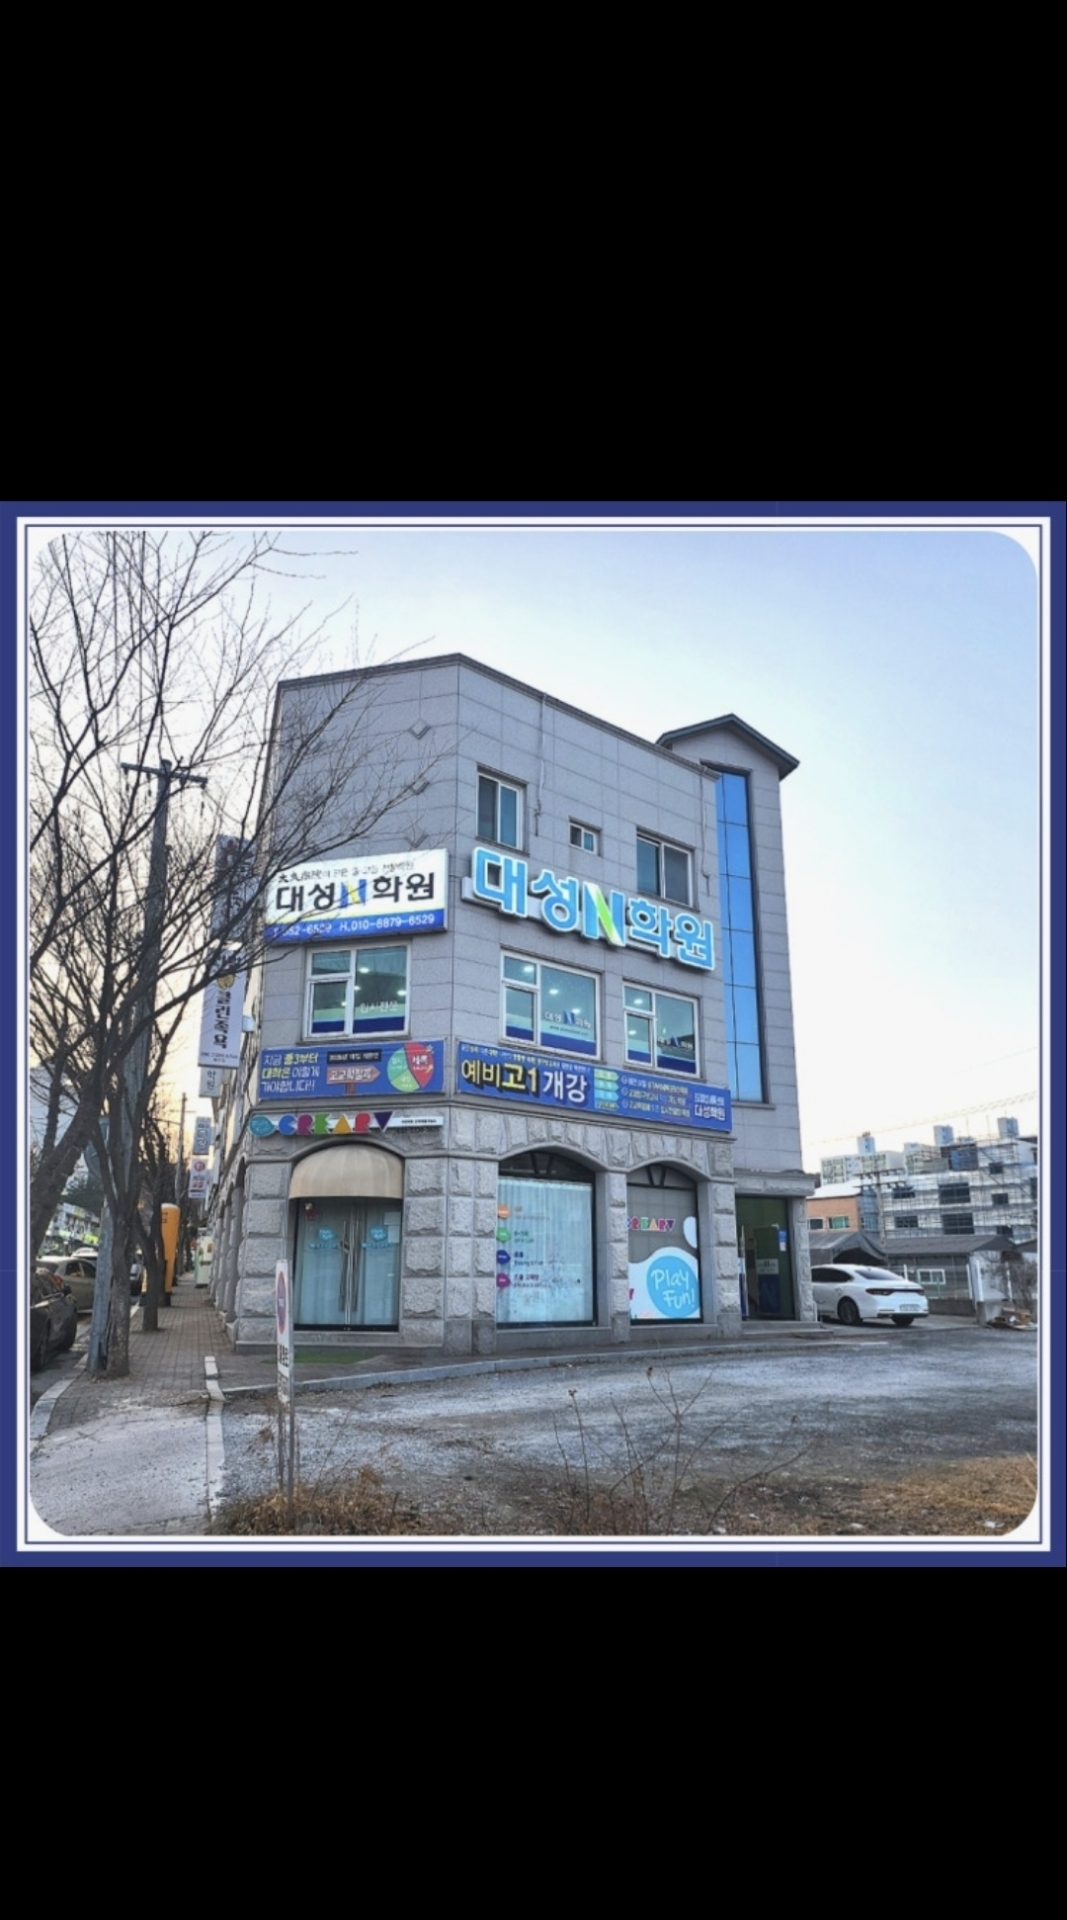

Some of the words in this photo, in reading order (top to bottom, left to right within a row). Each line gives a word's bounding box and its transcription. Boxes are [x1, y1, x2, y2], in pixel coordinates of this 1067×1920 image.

[263, 1054, 282, 1067] 지금
[542, 1070, 588, 1104] 개강
[650, 1267, 690, 1291] Play
[663, 1288, 696, 1308] Fun!
